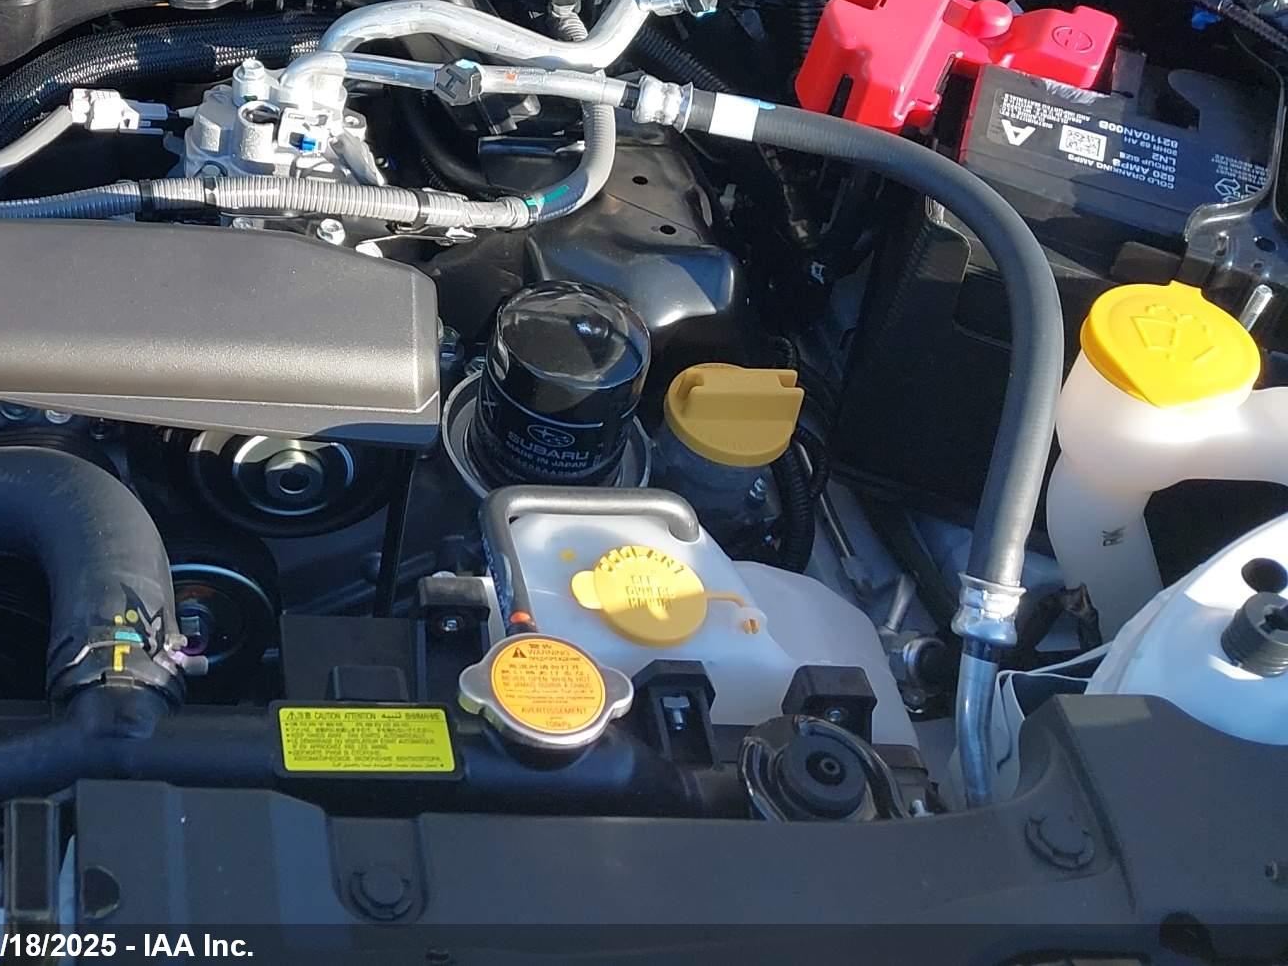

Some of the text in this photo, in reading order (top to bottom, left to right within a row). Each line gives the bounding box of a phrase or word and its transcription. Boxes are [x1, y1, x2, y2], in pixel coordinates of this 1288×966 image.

[1098, 120, 1179, 149] 82110AN00B
[1123, 135, 1138, 145] AH
[1112, 157, 1150, 175] AMPS
[1119, 151, 1176, 174] GROUP SIZE
[1151, 152, 1177, 166] LN2
[1067, 153, 1175, 190] COLD CRANKING AMPS
[508, 431, 589, 460] SUBARU
[536, 457, 549, 465] IN
[551, 460, 587, 468] JAPAN
[527, 648, 570, 657] WARNING
[314, 712, 377, 720] CAUTION ATTENTION
